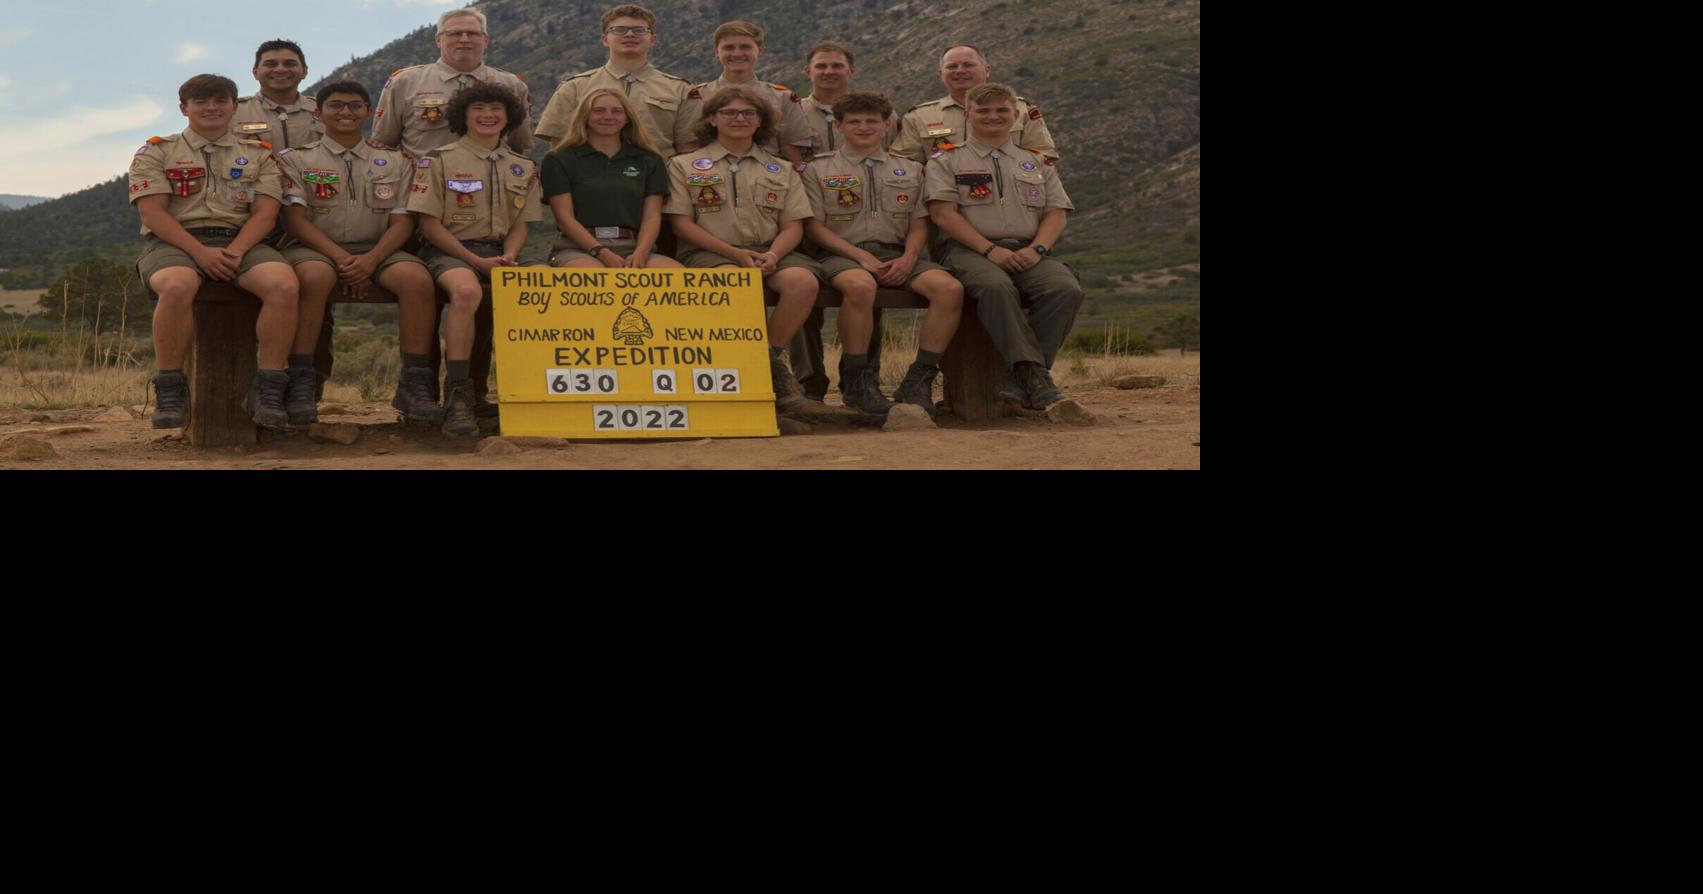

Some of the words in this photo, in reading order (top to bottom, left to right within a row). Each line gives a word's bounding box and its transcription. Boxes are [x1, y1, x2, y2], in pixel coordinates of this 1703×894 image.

[502, 271, 608, 288] PHILMONT
[615, 272, 674, 288] SCOUT
[684, 272, 751, 287] RANCH
[560, 291, 614, 306] SCOUTS
[644, 292, 730, 306] AMERICA
[508, 329, 595, 341] CIMARRON
[666, 328, 703, 341] NEW
[709, 328, 763, 341] MEXICO
[555, 346, 712, 366] EXPEDITION
[551, 375, 615, 393] 630
[656, 375, 673, 392] Q
[697, 374, 737, 392] 02
[598, 409, 685, 428] 2022
